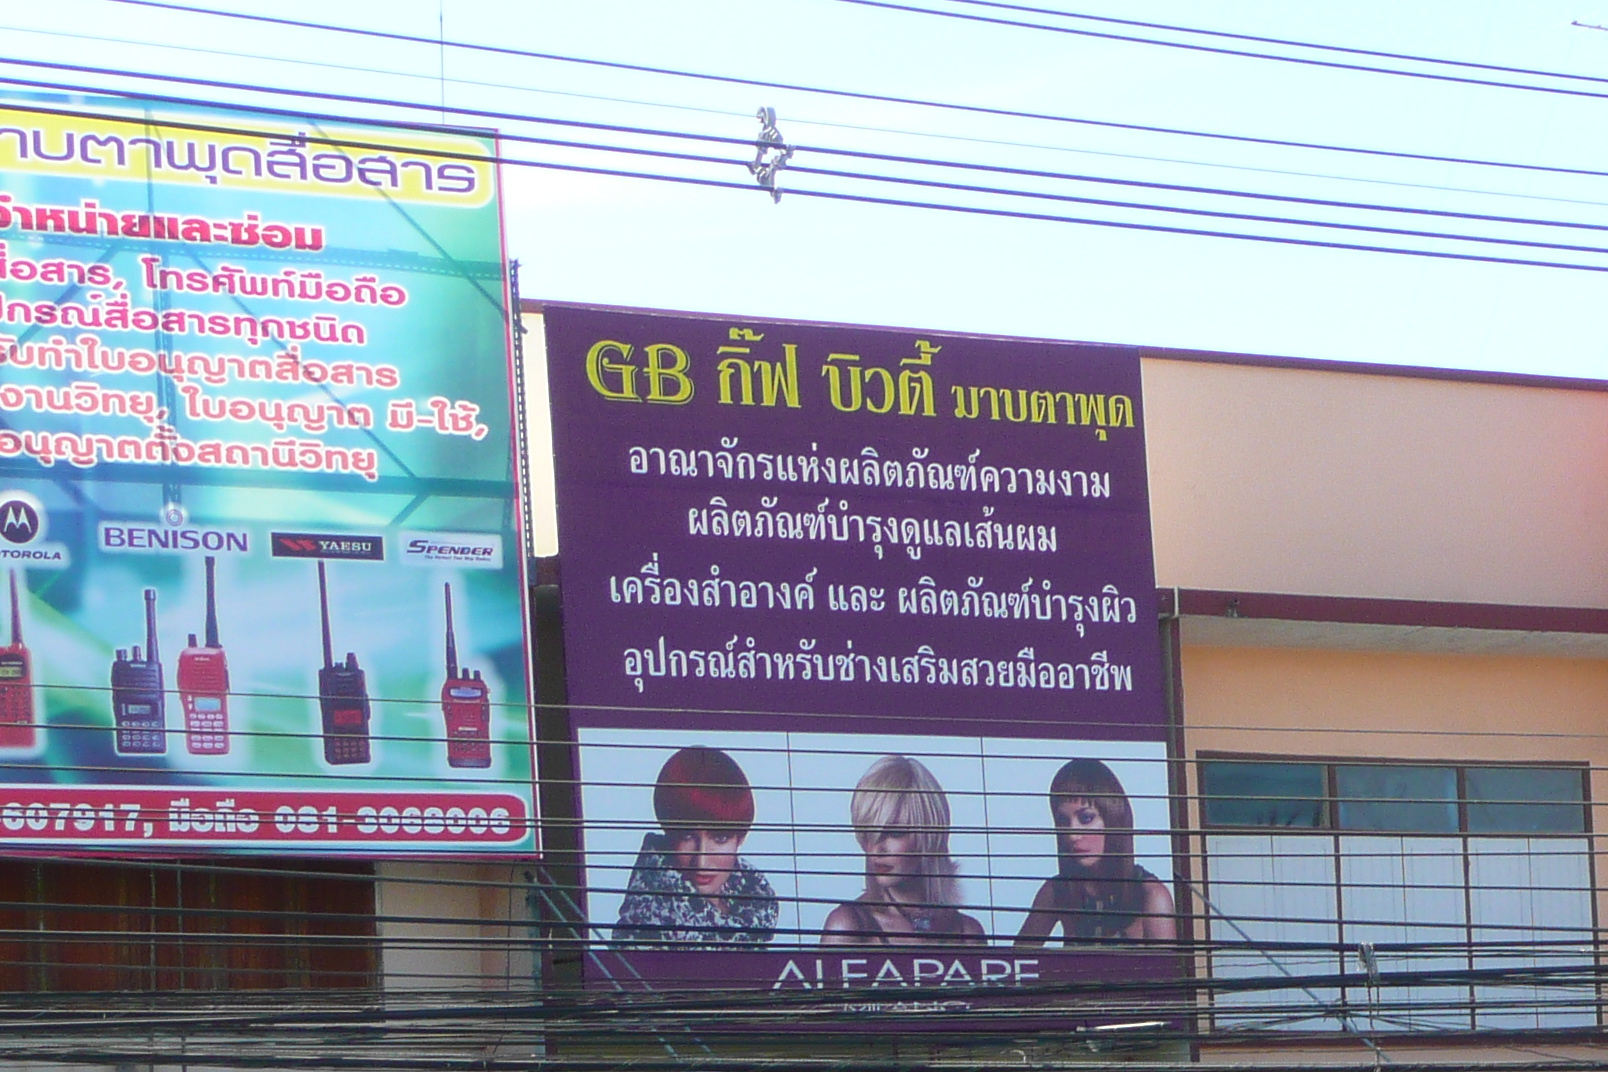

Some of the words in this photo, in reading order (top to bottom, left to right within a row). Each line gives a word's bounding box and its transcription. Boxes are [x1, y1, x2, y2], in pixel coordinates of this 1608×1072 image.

[141, 256, 407, 306] โทรศัพท์มือถือ
[0, 292, 365, 345] กรณ์สื่อสารทุกชนิด
[182, 386, 372, 430] ใบอนุญาต
[586, 340, 695, 405] GB
[717, 327, 803, 410] กิ๊ฟ
[821, 340, 942, 417] บิวตี้
[951, 385, 1136, 442] มาบตาพุด
[629, 437, 1111, 499] อาณาจักรแห่งผลิตภัณฑ์ความงาม
[104, 527, 248, 552] BENISON
[318, 540, 372, 552] YAESU
[687, 495, 1058, 560] ผลิตภัณฑ์บำรุงดูแลเส้นผม
[610, 553, 818, 612] เครื่องสำอางค์
[828, 581, 886, 613] และ
[898, 575, 1138, 637] ผลิตภัณฑ์บำรุงผิว
[623, 635, 1133, 693] อุปกรณ์สำหรับช่างเสริมสวยมืออาชีพ
